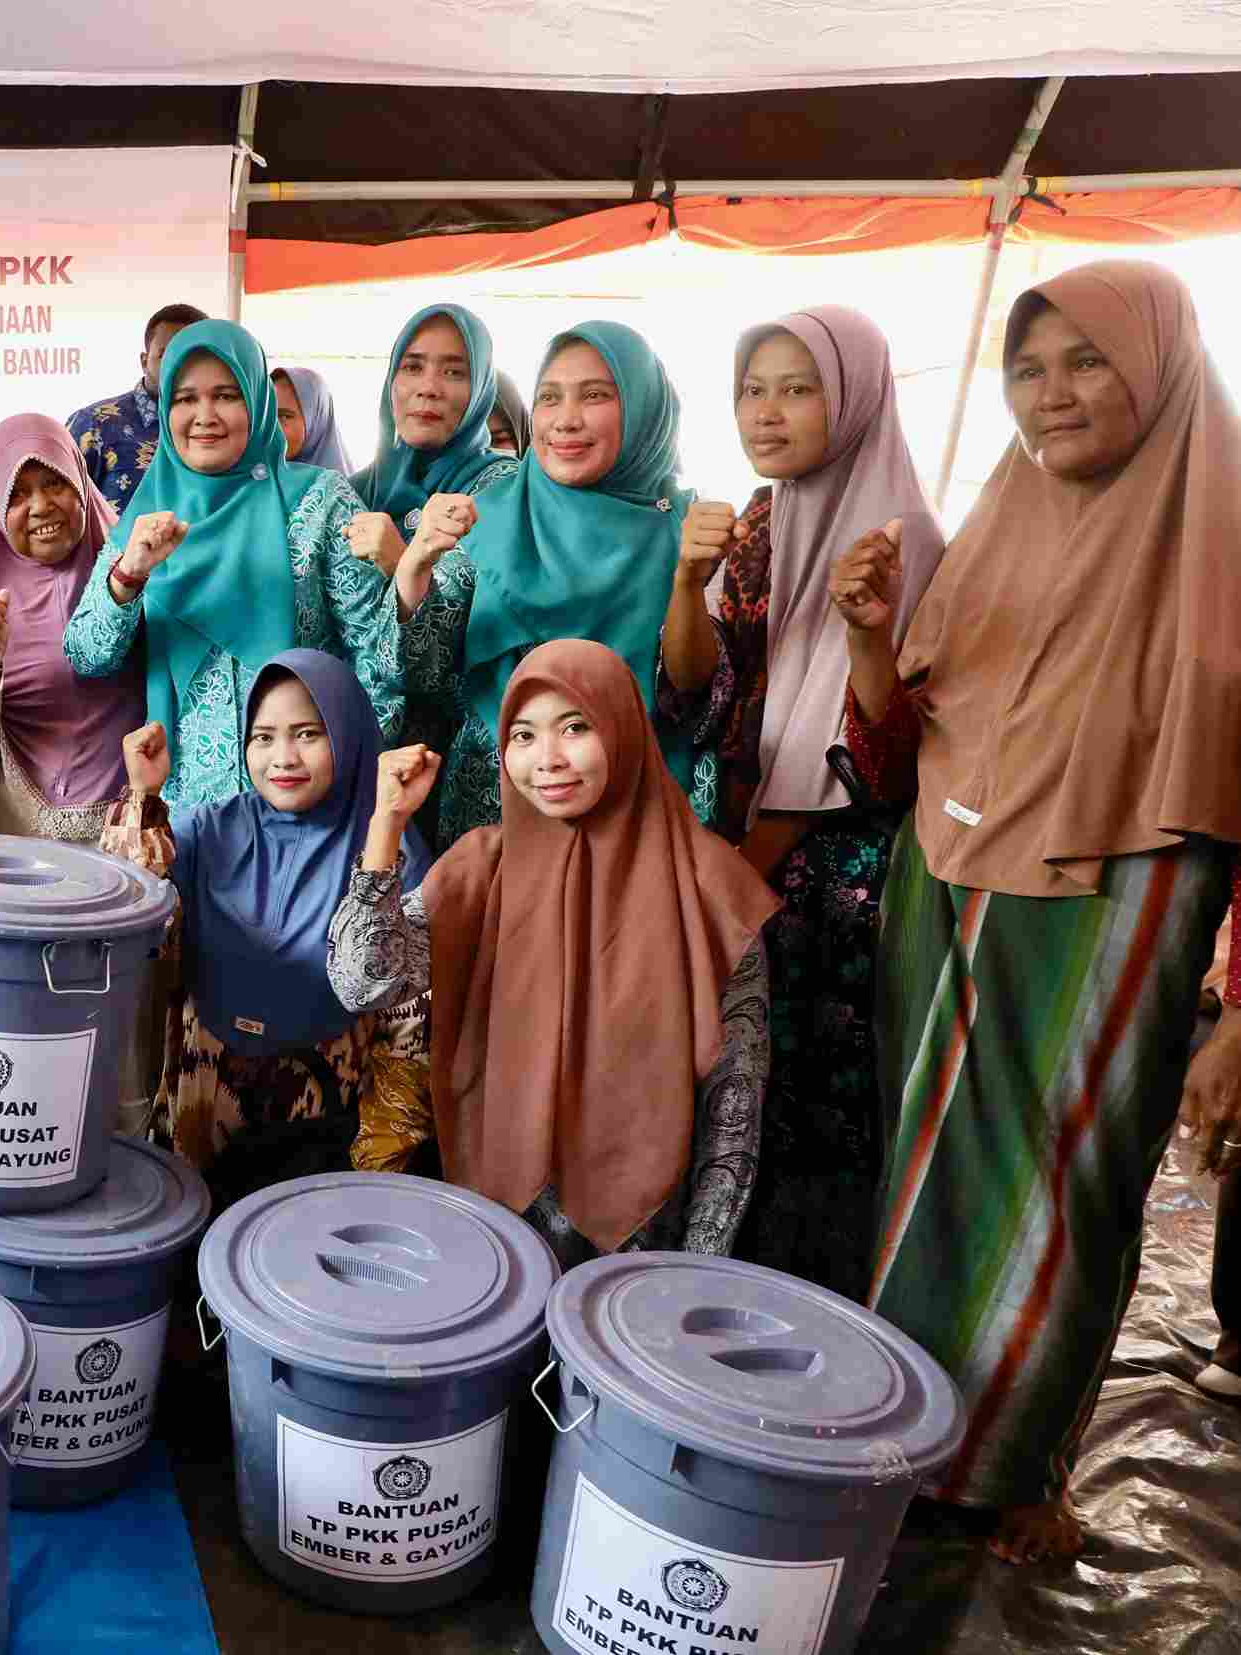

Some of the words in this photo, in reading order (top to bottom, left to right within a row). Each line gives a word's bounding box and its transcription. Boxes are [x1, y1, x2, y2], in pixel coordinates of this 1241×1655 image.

[0, 256, 74, 286] PKK
[4, 347, 81, 375] BANJIR
[38, 1378, 136, 1404] BANTUAN
[41, 1413, 86, 1428] PKK
[94, 1393, 148, 1426] PUSAT
[66, 1437, 80, 1450] &
[338, 1494, 459, 1519] BANTUAN
[307, 1515, 337, 1534] TP
[346, 1528, 399, 1543] PKK
[408, 1505, 481, 1541] PUSAT
[291, 1530, 371, 1565] EMBER
[380, 1552, 398, 1565] &
[406, 1518, 492, 1563] GAYUNG
[585, 1594, 613, 1621] TP
[620, 1618, 678, 1655] PKK
[617, 1587, 759, 1643] BANTUAN
